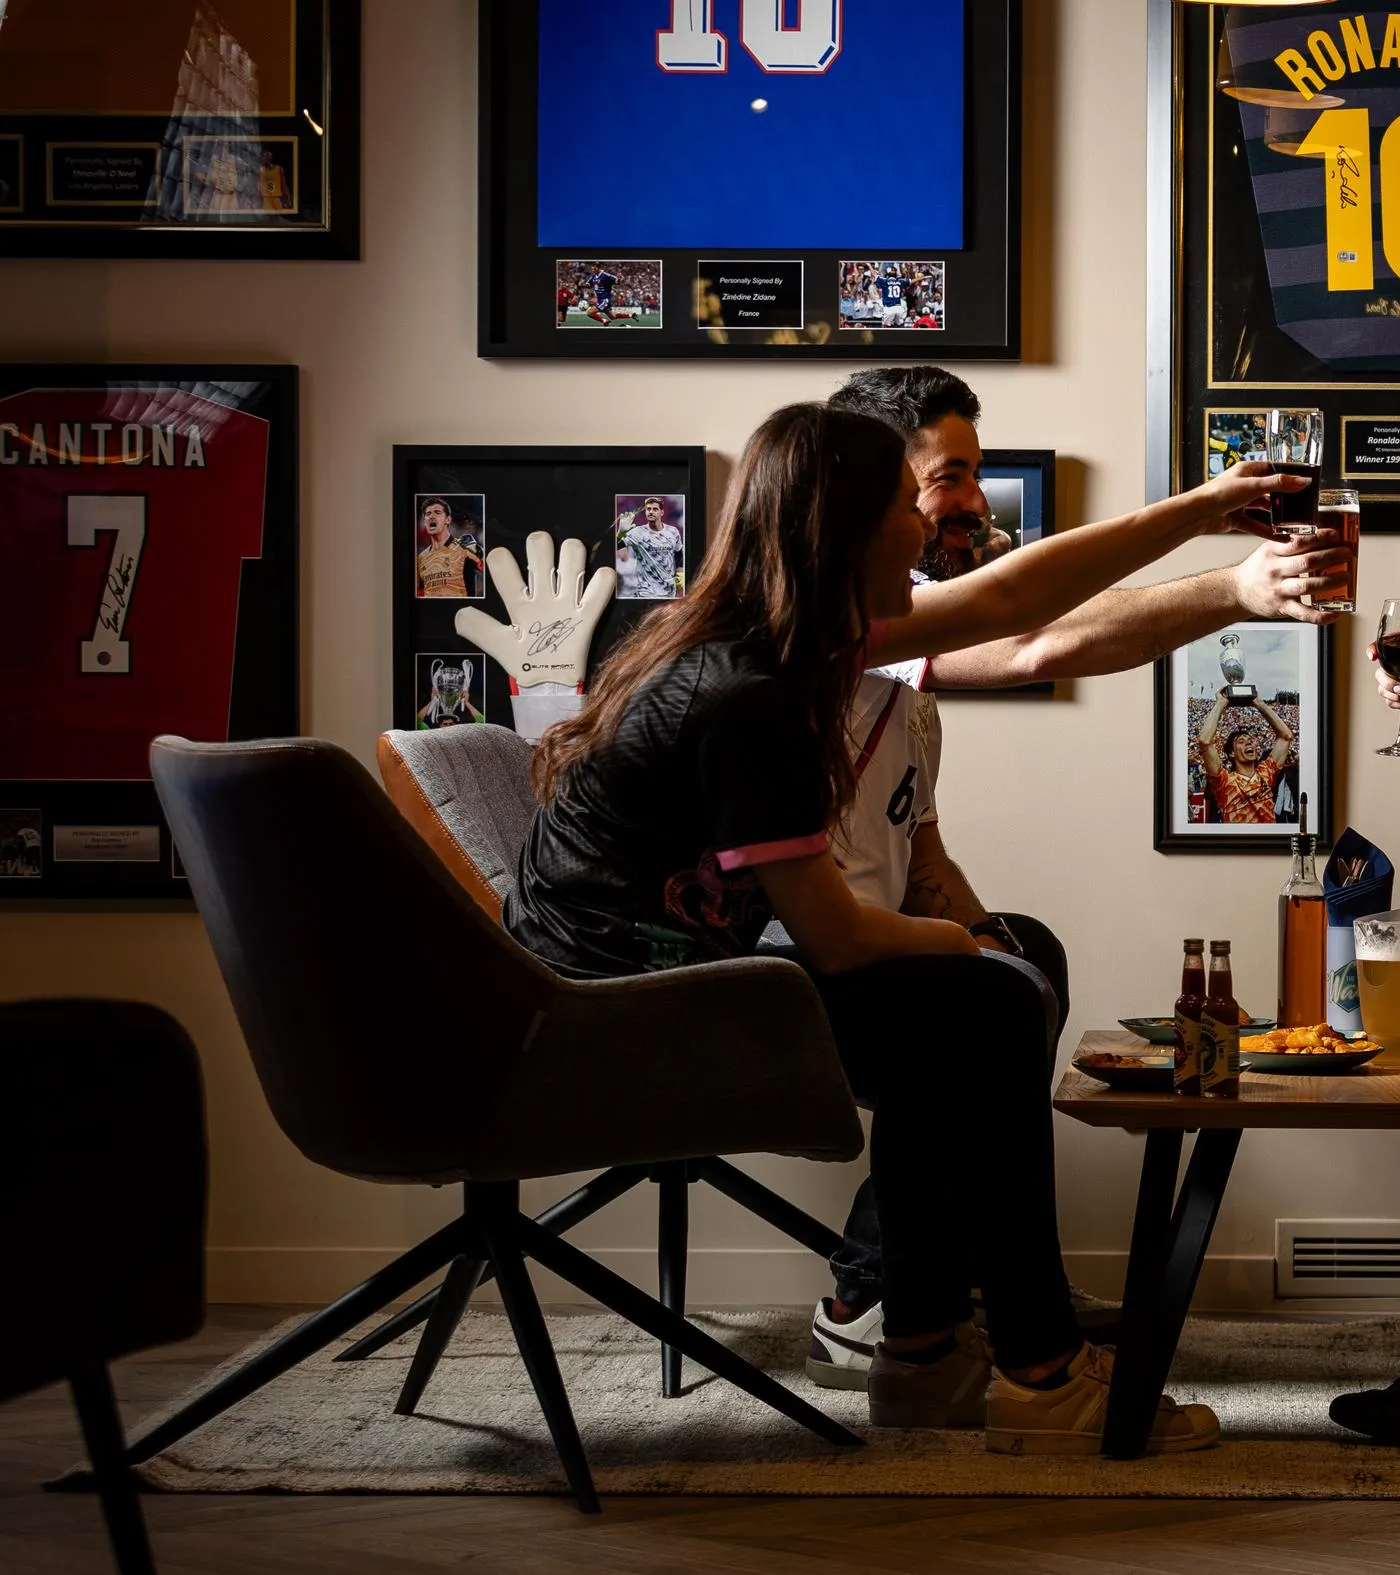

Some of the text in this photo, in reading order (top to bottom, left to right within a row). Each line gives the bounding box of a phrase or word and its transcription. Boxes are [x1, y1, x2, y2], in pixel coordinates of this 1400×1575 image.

[719, 276, 784, 286] Personally Signed By
[752, 293, 777, 302] Zidane
[738, 309, 760, 317] France
[1373, 426, 1400, 435] Personally
[0, 421, 208, 468] CANTONA
[1367, 436, 1400, 445] Ronaldo
[1355, 455, 1385, 463] Winner
[66, 494, 148, 674] 7
